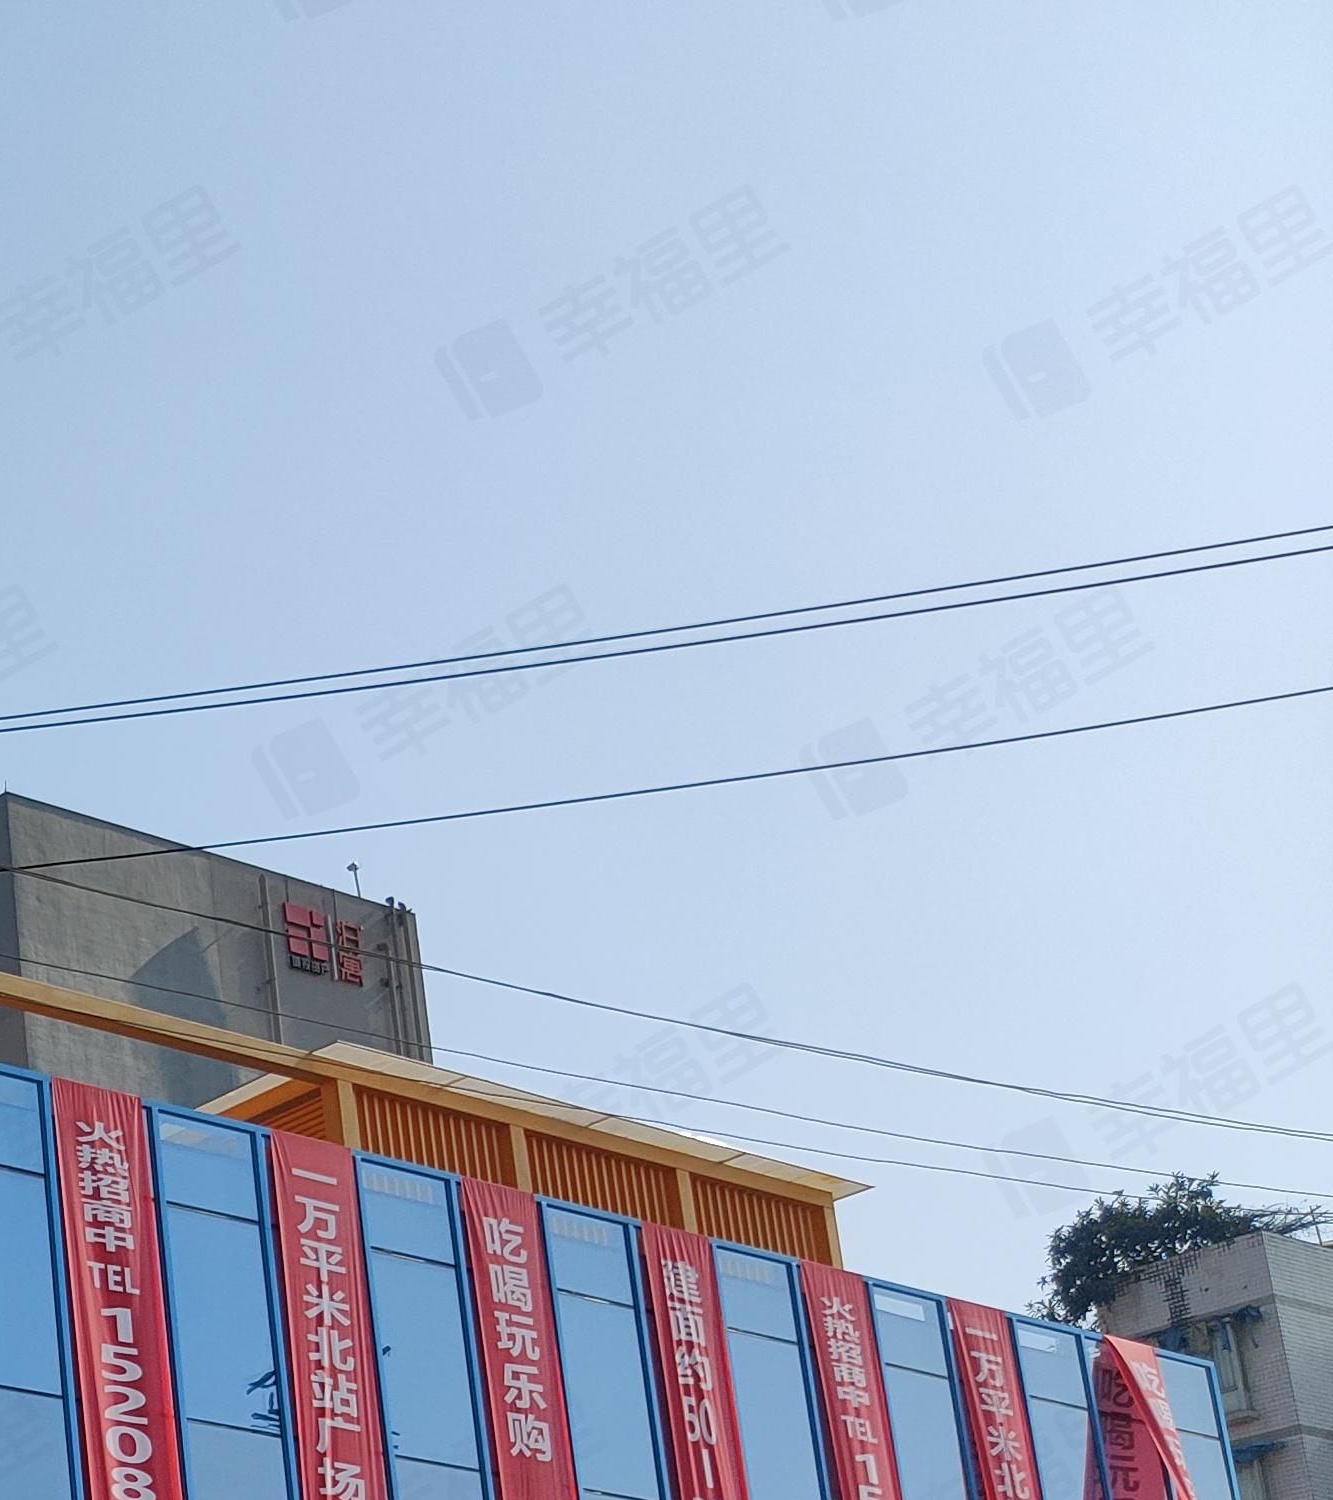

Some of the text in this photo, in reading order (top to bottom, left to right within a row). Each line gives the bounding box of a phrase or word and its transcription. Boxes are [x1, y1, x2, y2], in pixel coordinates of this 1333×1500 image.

[77, 1121, 135, 1253] 火热招商中
[87, 1262, 141, 1296] TEL
[484, 1217, 553, 1461] 吃喝玩乐购
[822, 1297, 870, 1410] 火热招商中
[842, 1414, 876, 1445] TEL
